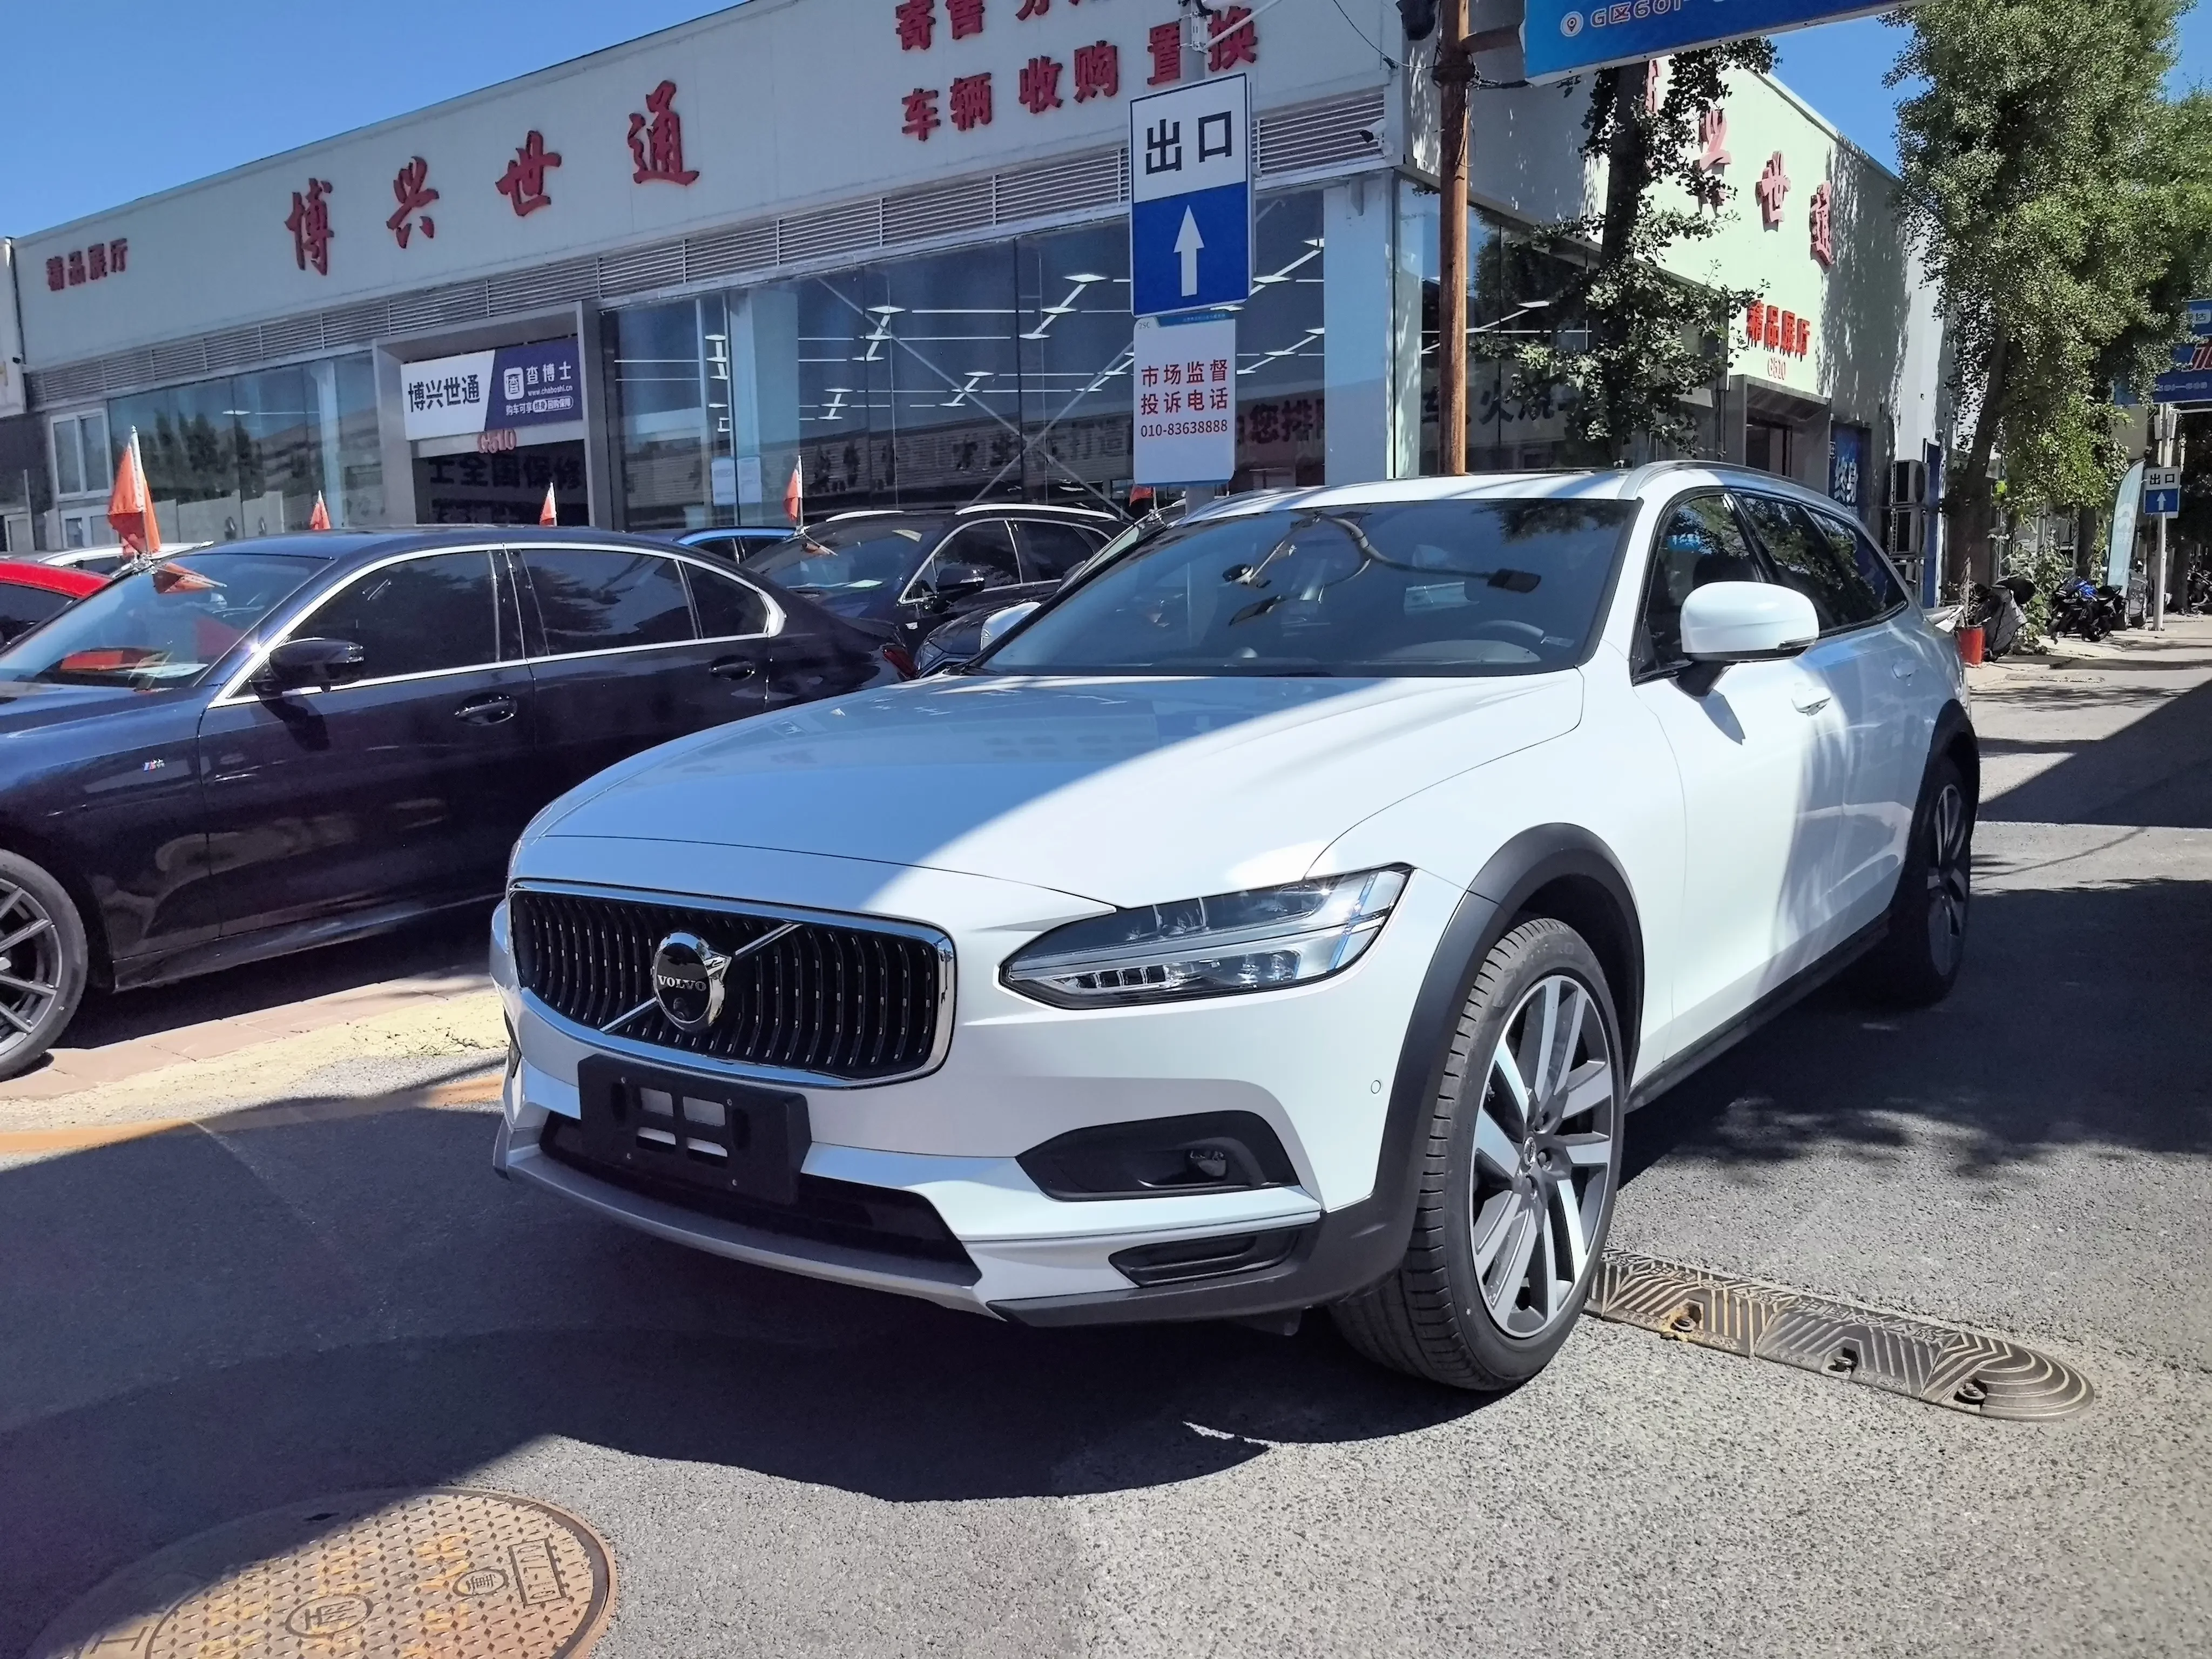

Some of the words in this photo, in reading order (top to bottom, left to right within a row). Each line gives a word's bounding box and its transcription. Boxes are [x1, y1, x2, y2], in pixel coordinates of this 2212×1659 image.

[902, 72, 993, 141] 车辆
[1019, 41, 1118, 113] 收购
[1147, 5, 1258, 85] 置换
[1145, 111, 1232, 175] 出口
[285, 79, 700, 276] 博兴世通
[525, 361, 572, 385] 查博士
[1141, 359, 1228, 387] 市场监督
[408, 374, 481, 413] 博兴世通
[1141, 387, 1228, 415] 投诉电话
[1141, 419, 1228, 437] 010-83638888
[2149, 473, 2175, 485] 出口
[657, 974, 706, 992] VOLVO
